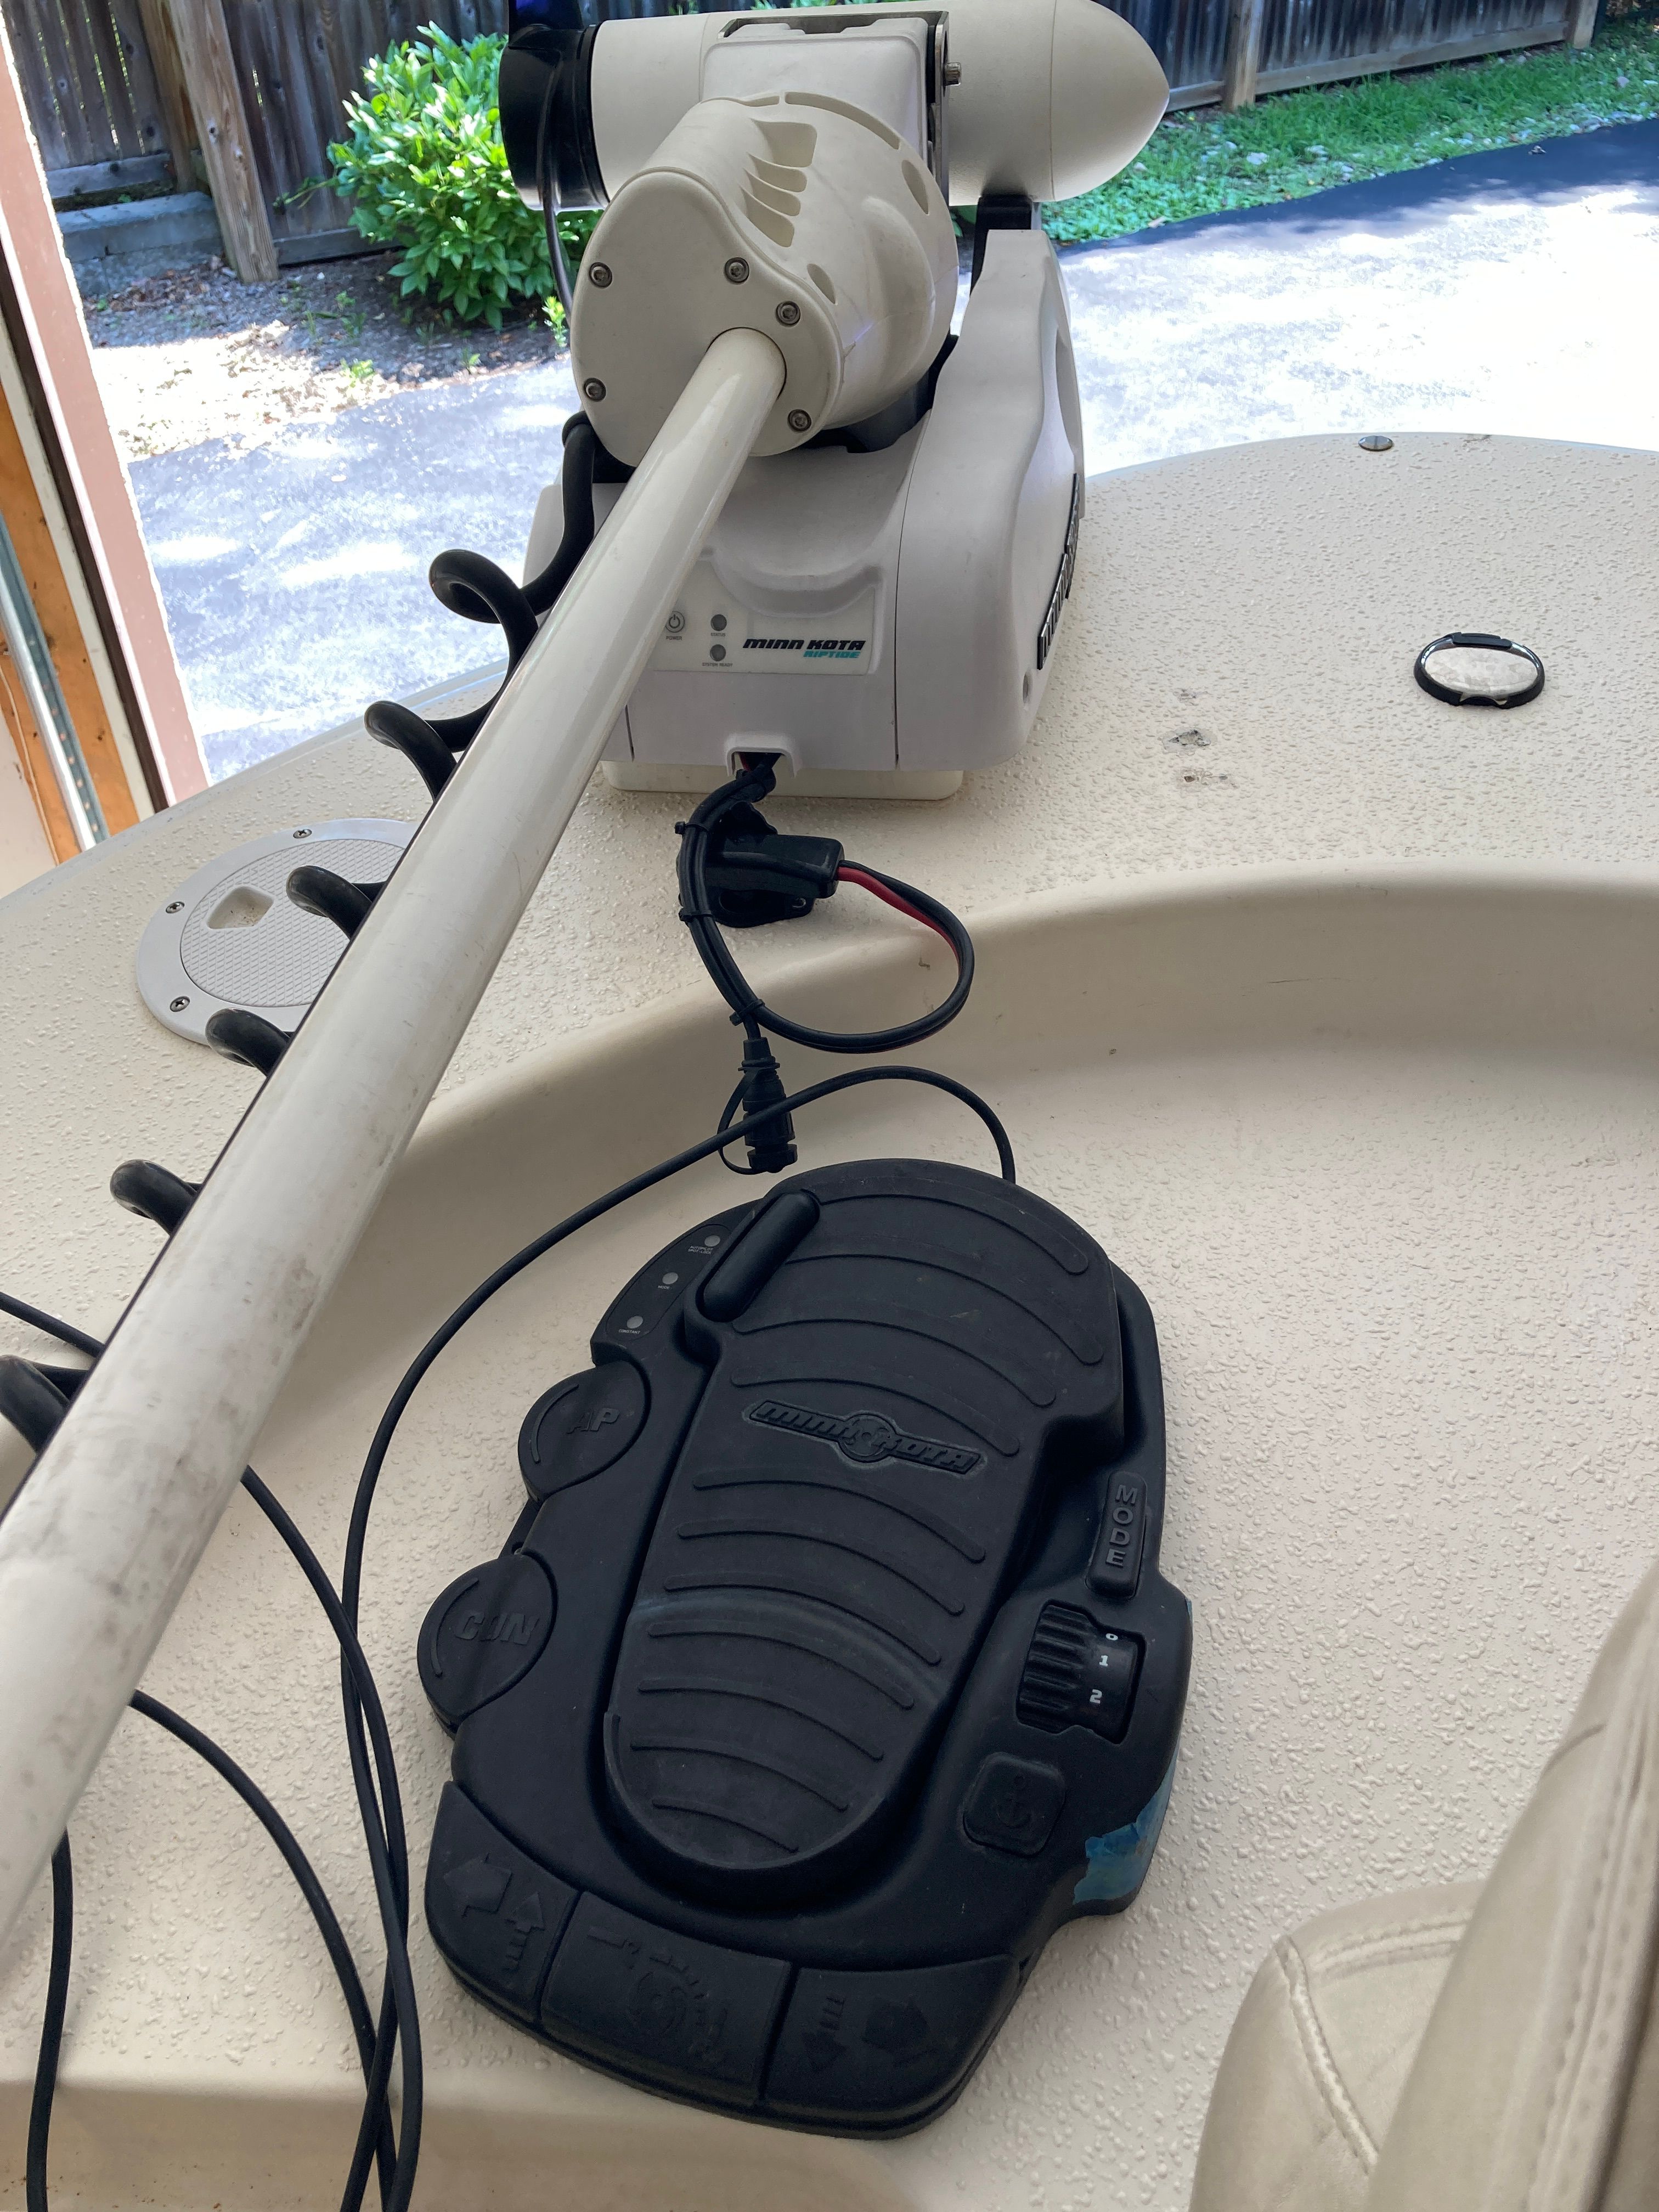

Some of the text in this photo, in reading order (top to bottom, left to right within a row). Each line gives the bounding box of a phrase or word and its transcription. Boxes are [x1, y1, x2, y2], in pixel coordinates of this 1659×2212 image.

[742, 639, 866, 651] MINN KOTA
[566, 1407, 620, 1434] AP
[1105, 1483, 1139, 1568] MODE
[453, 1611, 539, 1645] CON
[1105, 1632, 1119, 1642] 0
[1099, 1655, 1109, 1667] 1
[1090, 1689, 1103, 1704] 2
